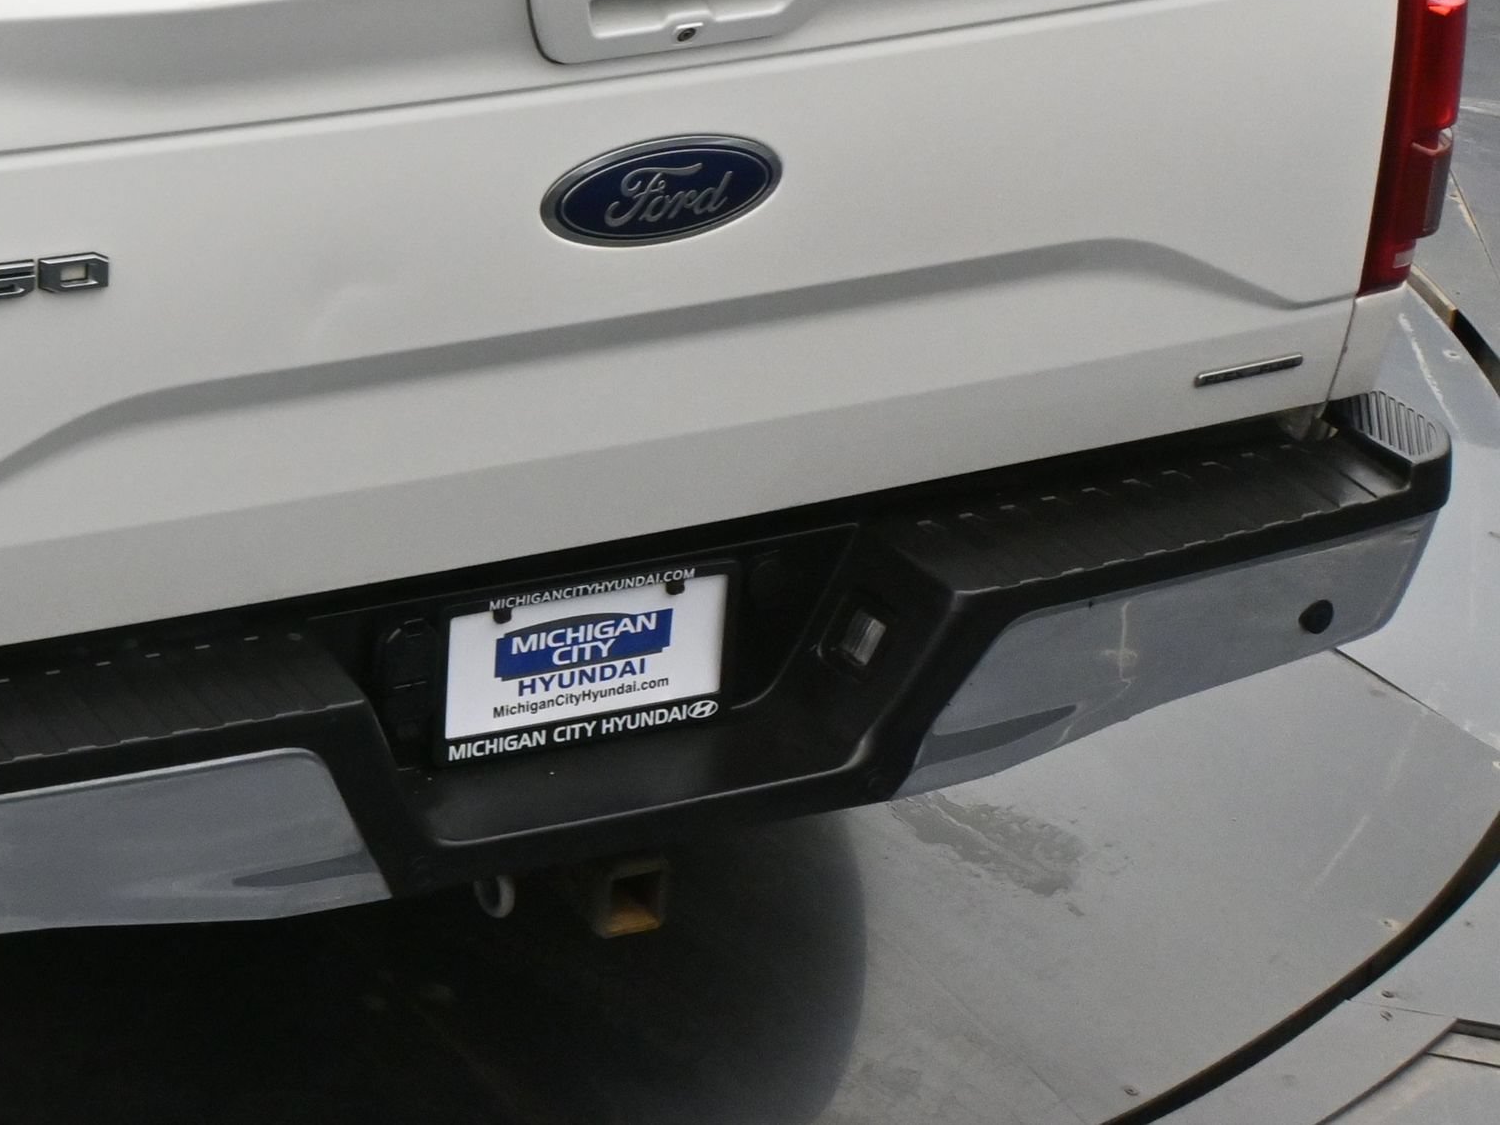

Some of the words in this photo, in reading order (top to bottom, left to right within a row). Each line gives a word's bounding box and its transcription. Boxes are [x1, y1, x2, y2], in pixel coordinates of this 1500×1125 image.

[604, 162, 733, 228] Ford
[488, 567, 696, 612] MICHIGANCITYHYUNDAI.COM
[510, 612, 657, 655] MICHIGAN
[552, 639, 616, 667] CITY
[492, 676, 670, 720] MichiganCityHyundai.com
[517, 658, 646, 697] HYUNDAI
[447, 730, 547, 762] MICHIGAN
[553, 720, 597, 743] CITY
[602, 704, 688, 735] HYUNDAI
